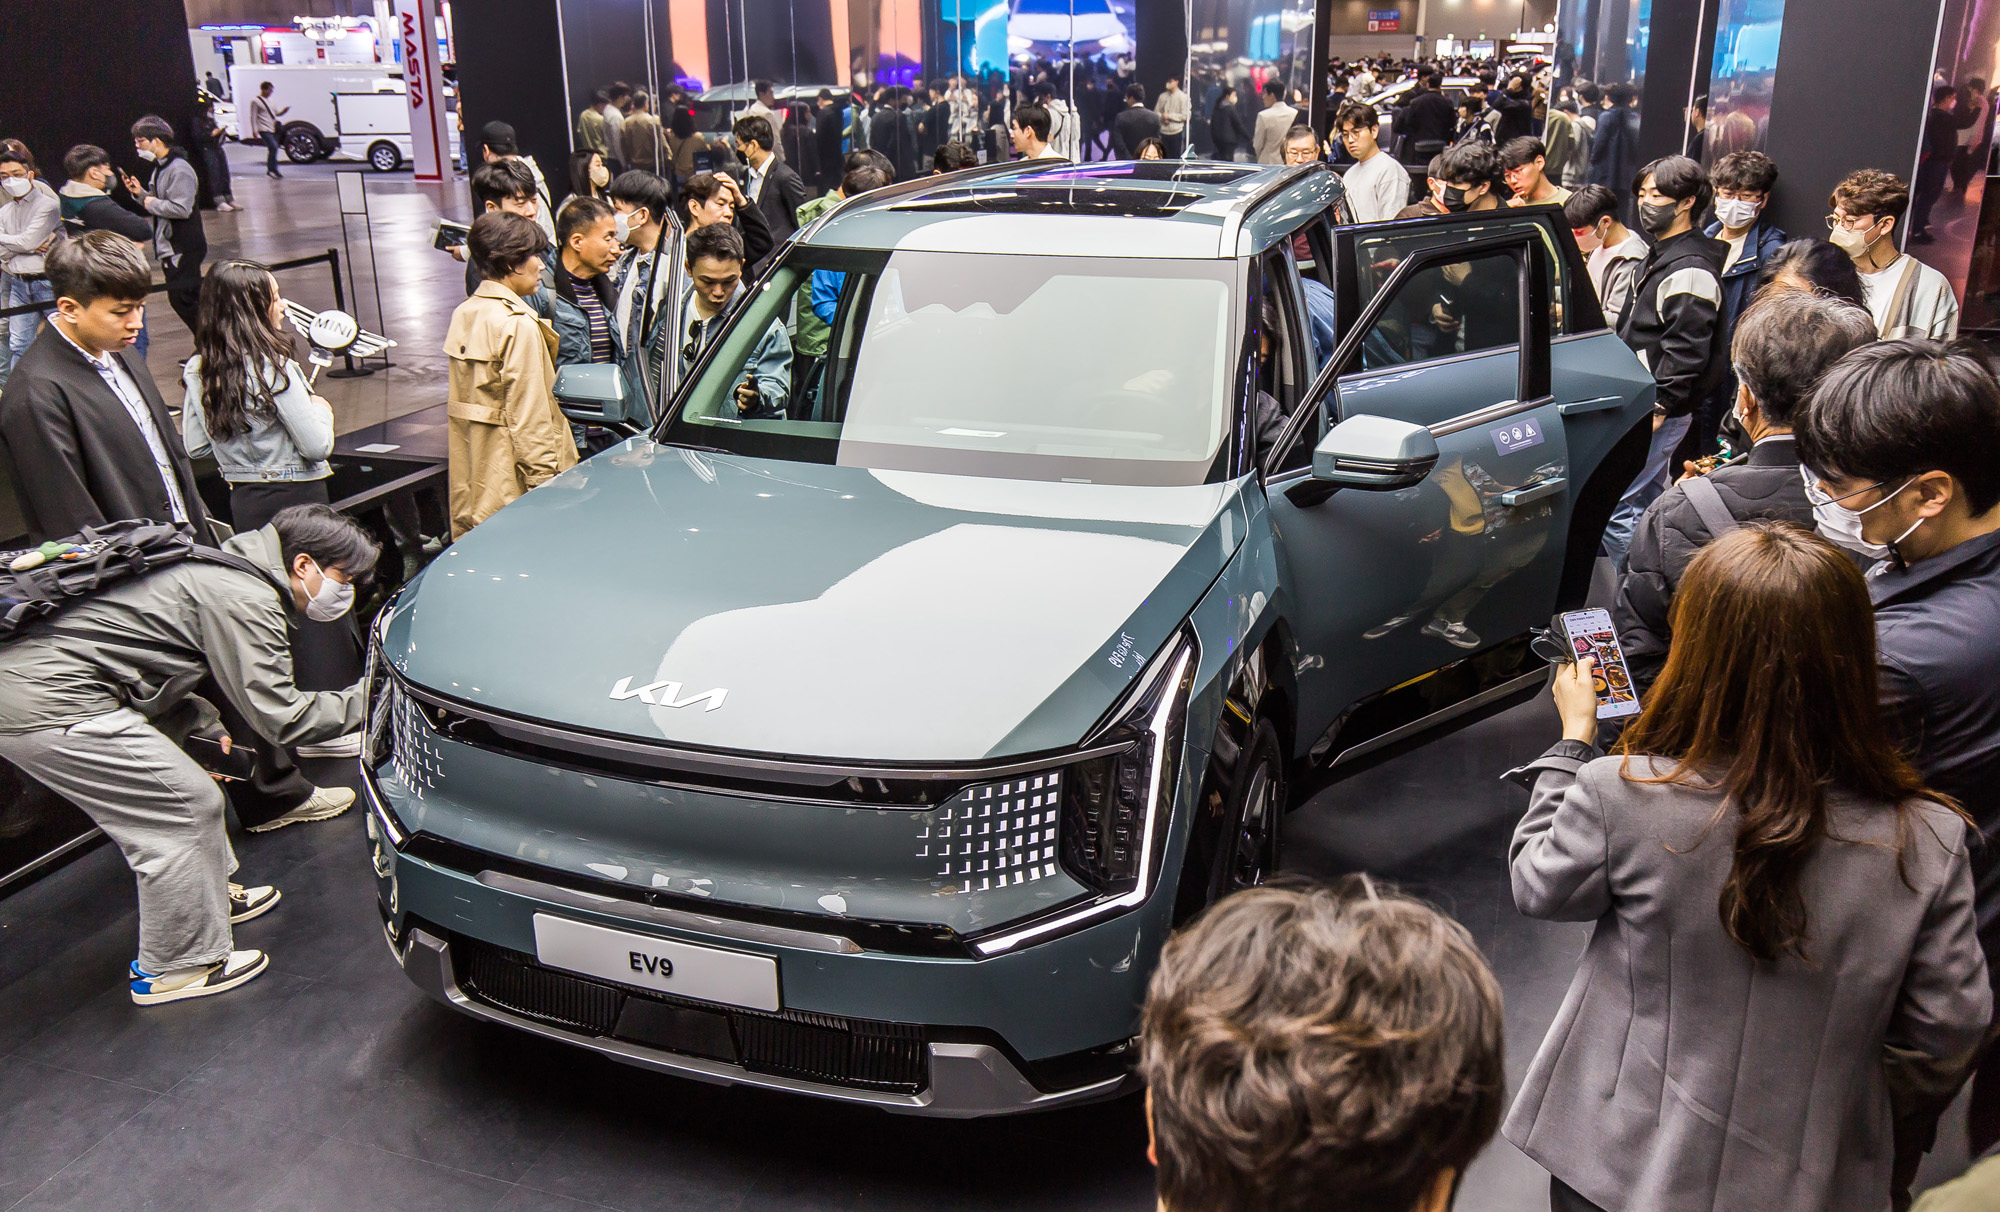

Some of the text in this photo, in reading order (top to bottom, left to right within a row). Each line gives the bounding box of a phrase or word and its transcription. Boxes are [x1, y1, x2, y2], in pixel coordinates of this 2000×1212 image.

[401, 11, 424, 110] MASTA
[314, 317, 353, 339] MINI
[608, 675, 729, 713] KIA
[628, 950, 674, 977] EV9
